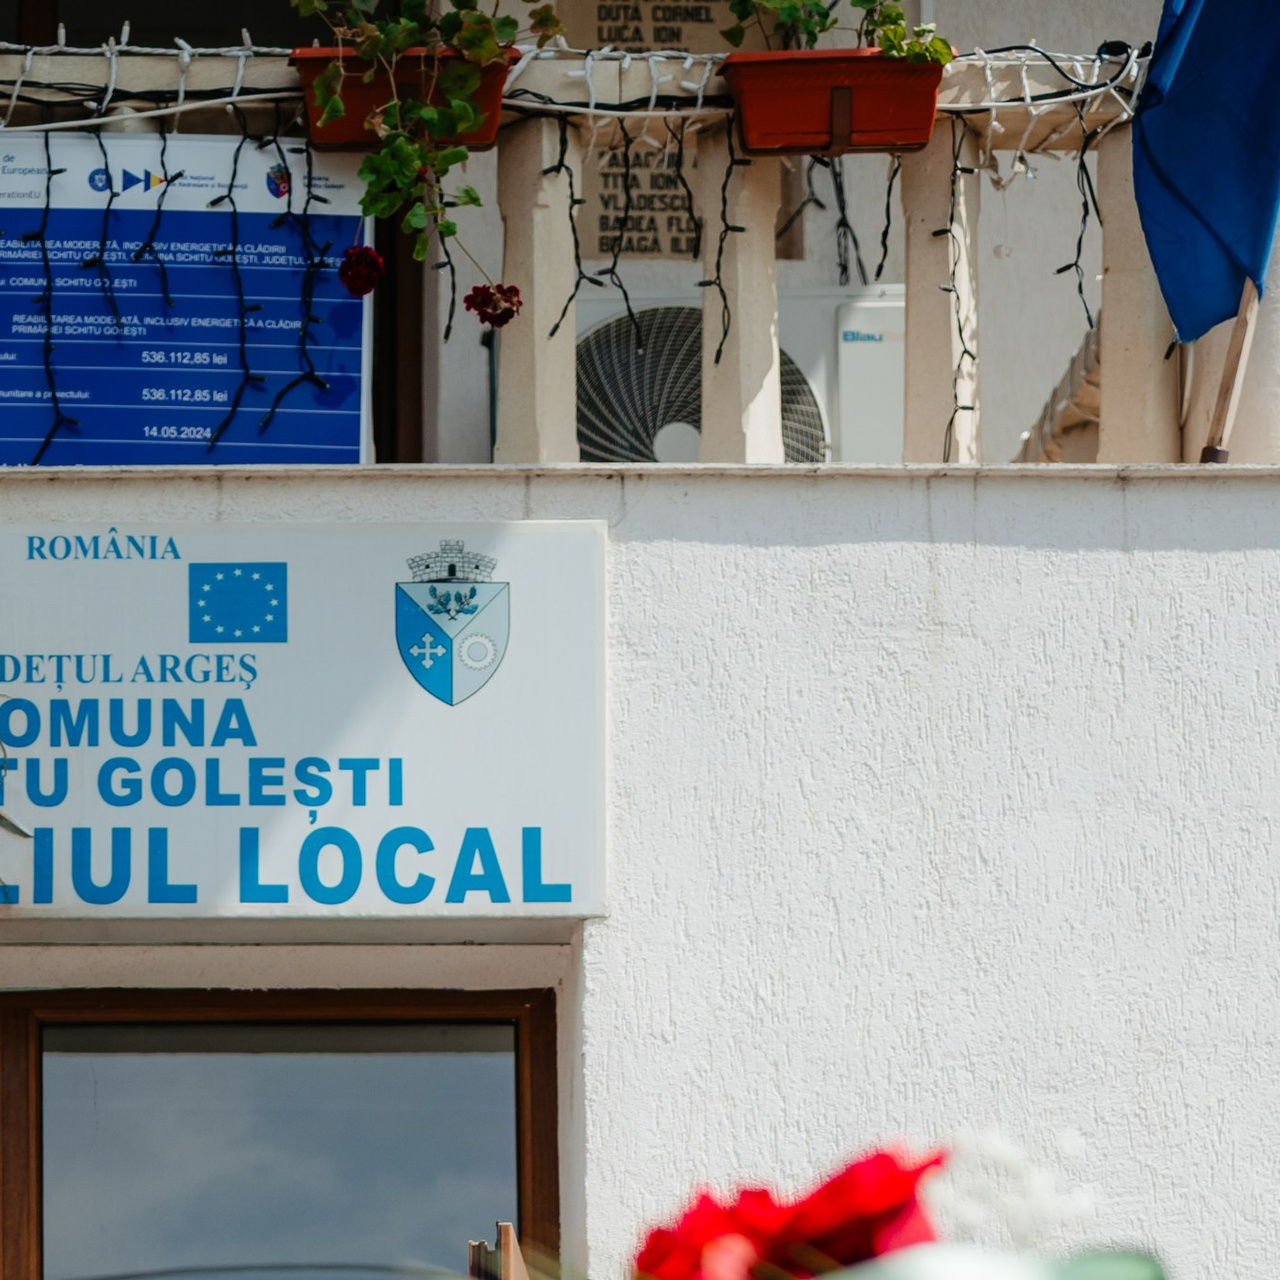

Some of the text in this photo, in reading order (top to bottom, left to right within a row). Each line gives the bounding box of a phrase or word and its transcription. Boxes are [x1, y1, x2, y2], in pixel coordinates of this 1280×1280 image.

[141, 351, 211, 365] 536.112,85
[141, 388, 211, 402] 536.112,85
[143, 426, 212, 438] 14.05.2024
[26, 527, 181, 560] ROMÂNIA
[130, 653, 258, 691] ARGEȘ
[97, 756, 404, 825] GOLEȘTI
[239, 826, 572, 905] LOCAL
